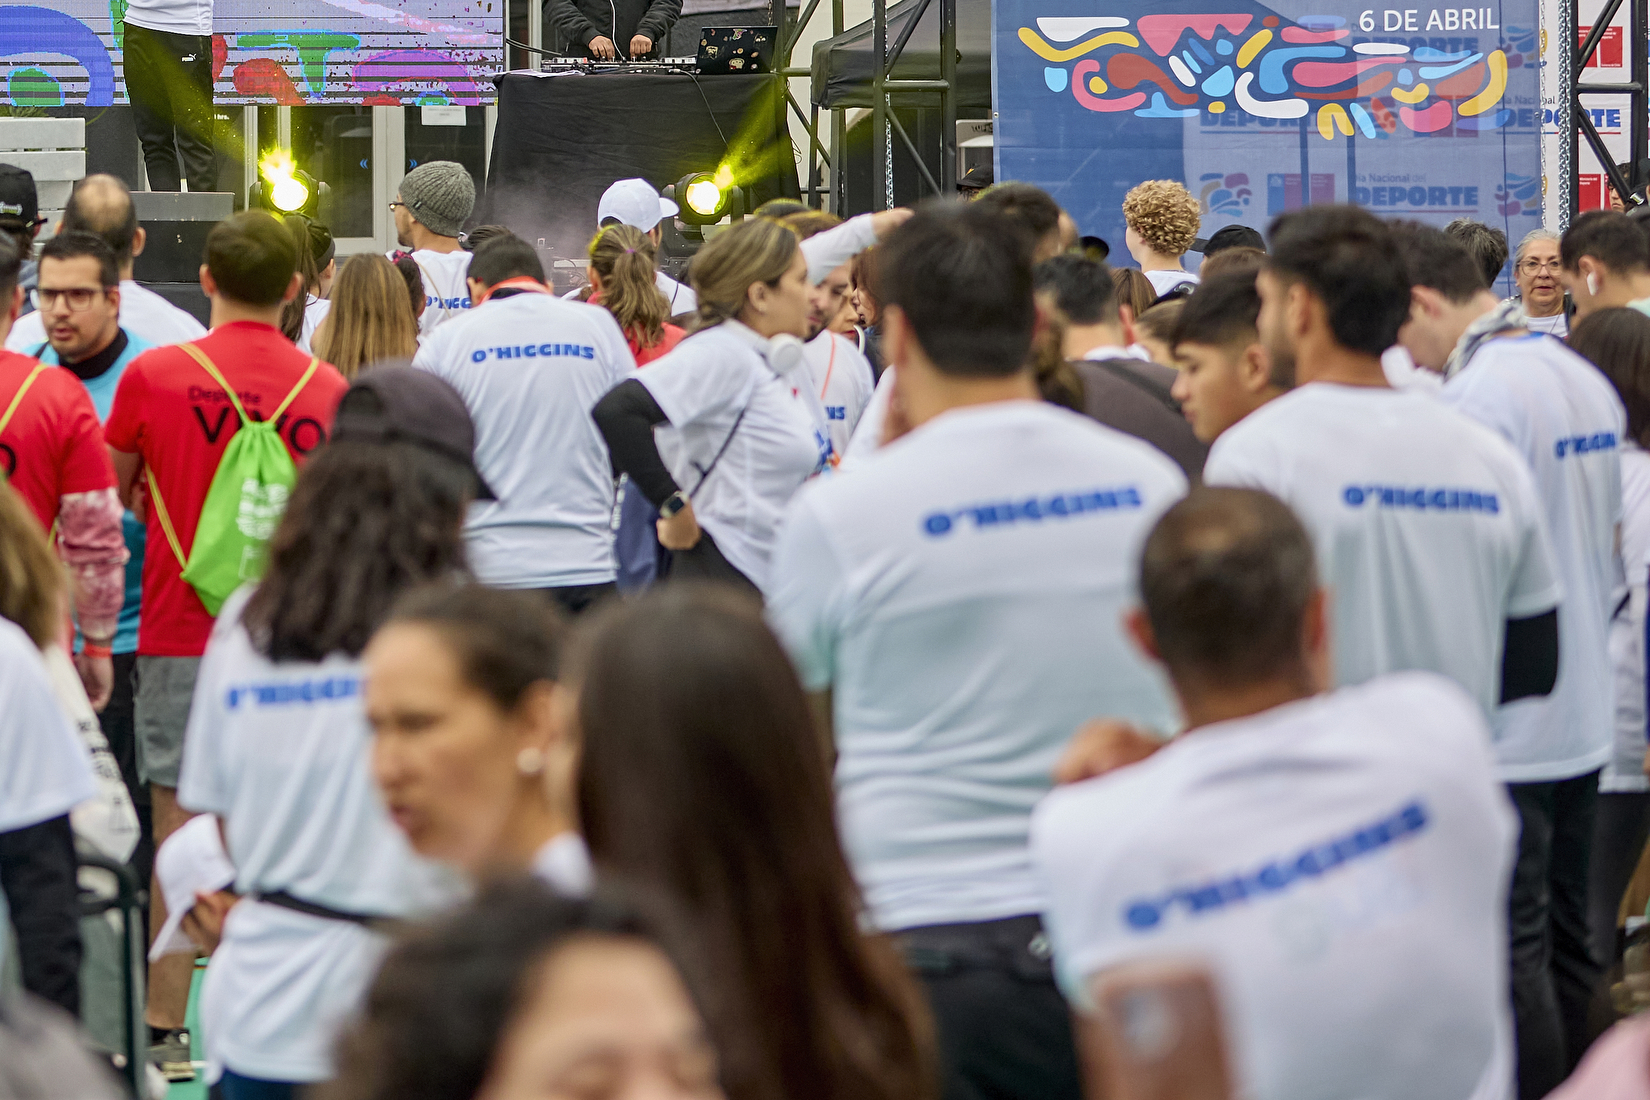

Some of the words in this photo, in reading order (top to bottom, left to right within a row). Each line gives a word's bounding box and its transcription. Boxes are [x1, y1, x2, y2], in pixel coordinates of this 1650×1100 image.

[1359, 10, 1375, 32] 6
[1384, 10, 1419, 32] DE
[1426, 8, 1500, 31] ABRIL
[1355, 186, 1478, 206] DEPORTE
[471, 343, 594, 363] O'HIGGINS
